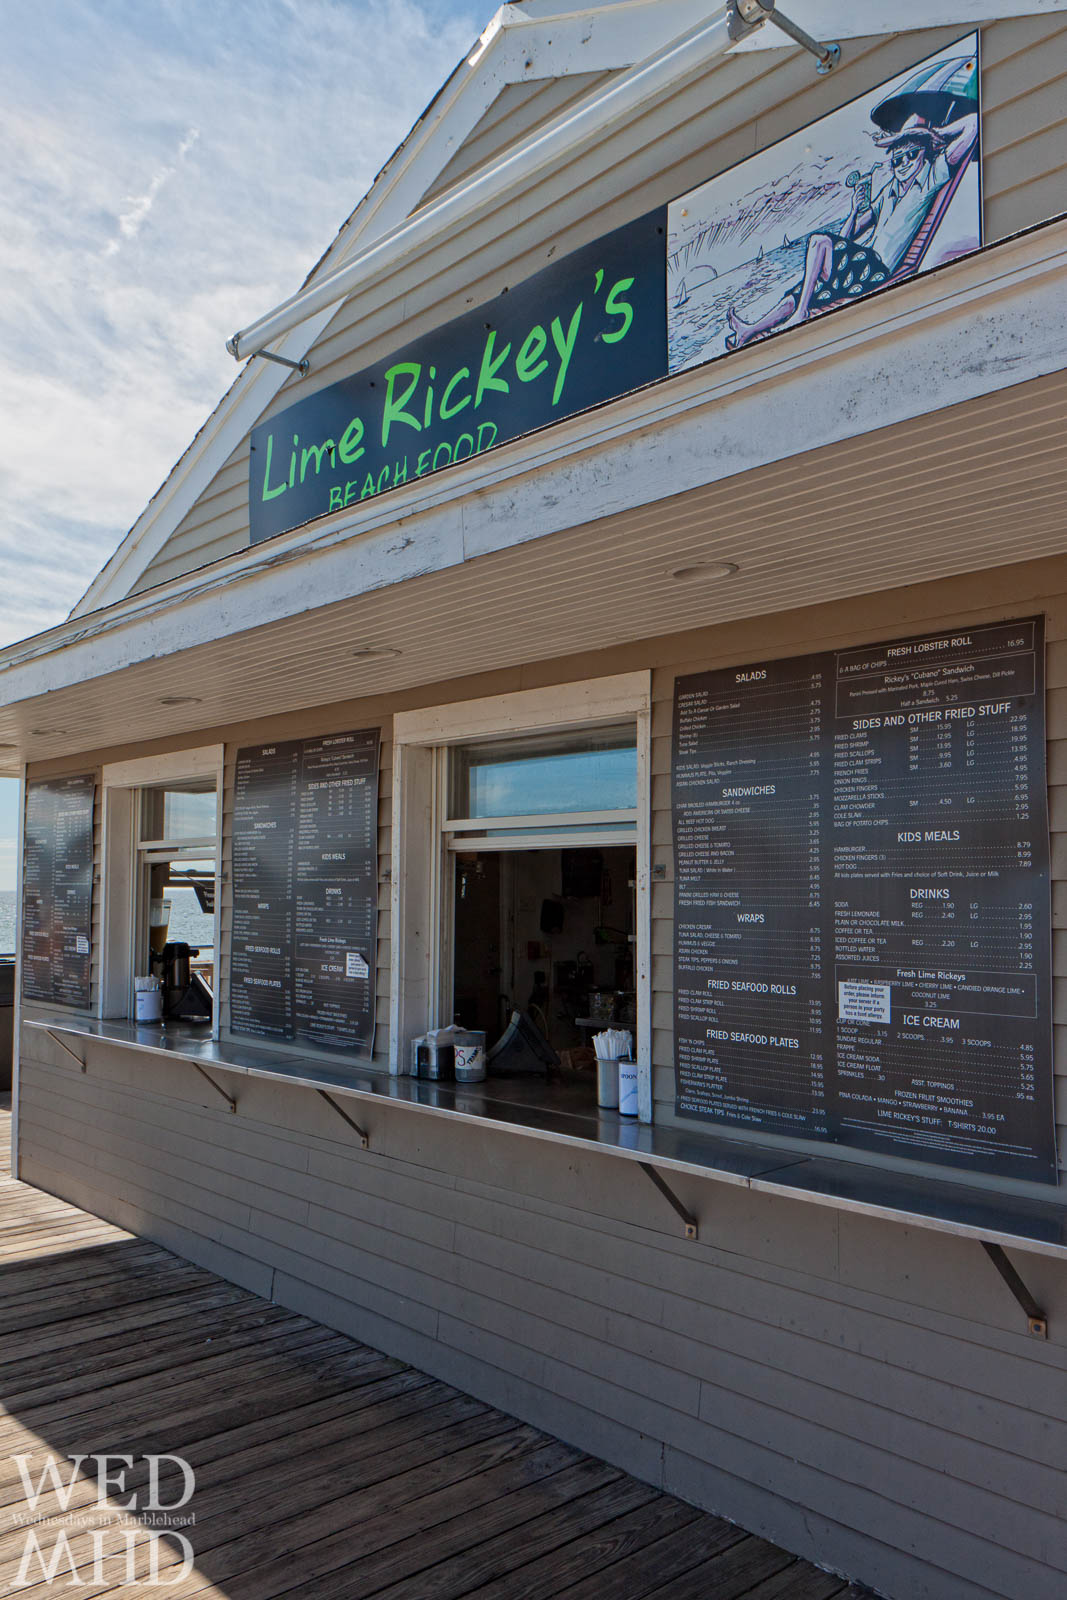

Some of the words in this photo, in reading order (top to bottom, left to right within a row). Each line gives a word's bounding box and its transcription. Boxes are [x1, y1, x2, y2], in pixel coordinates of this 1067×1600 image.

[262, 416, 365, 501] Lime
[382, 268, 635, 448] Rickey's
[328, 454, 409, 512] BEACH
[416, 421, 499, 479] FOOD
[888, 647, 912, 657] FRESH
[914, 641, 949, 654] LOBSTER
[951, 636, 972, 648] ROLL
[850, 663, 861, 672] BAG
[870, 660, 887, 669] CHIPS
[1007, 639, 1025, 647] 16.95
[736, 670, 767, 683] SALADS
[885, 673, 910, 684] Rickey's
[911, 668, 941, 680] "Cubano"
[942, 664, 975, 676] Sandwich
[852, 719, 881, 730] SIDES
[884, 716, 906, 727] AND
[908, 711, 942, 724] OTHER
[945, 706, 976, 720] FRIED
[979, 702, 1011, 716] STUFF
[1010, 715, 1027, 723] 22.95
[722, 785, 776, 797] SANDWICHES
[898, 832, 922, 842] KIDS
[924, 831, 960, 841] MEALS
[910, 889, 950, 899] DRINKS
[737, 914, 764, 923] WRAPS
[897, 969, 916, 978] Fresh
[918, 970, 936, 979] Lime
[938, 972, 966, 981] Rickeys
[708, 980, 729, 990] FRIED
[732, 981, 768, 993] SEAFOOD
[771, 985, 796, 995] ROLLS
[983, 986, 1006, 994] ORANGE
[903, 1015, 920, 1026] ICE
[923, 1016, 960, 1029] CREAM
[707, 1029, 728, 1039] FRIED
[731, 1032, 767, 1045] SEAFOOD
[770, 1037, 799, 1049] PLATES
[967, 1039, 992, 1047] SCOOPS
[927, 1081, 954, 1090] TOPPINGS
[1021, 1083, 1035, 1091] 5.25
[895, 1090, 918, 1099] FROZEN
[919, 1093, 935, 1102] FRUIT
[937, 1096, 974, 1107] SMOOTHIES
[903, 1101, 938, 1112] STRAWBERRY
[944, 1107, 968, 1116] BANANA
[982, 1112, 995, 1120] 3.95
[878, 1109, 892, 1119] LIME
[893, 1111, 920, 1123] RICKEY'S
[948, 1120, 976, 1132] T-SHIRTS
[978, 1125, 996, 1135] 20.00
